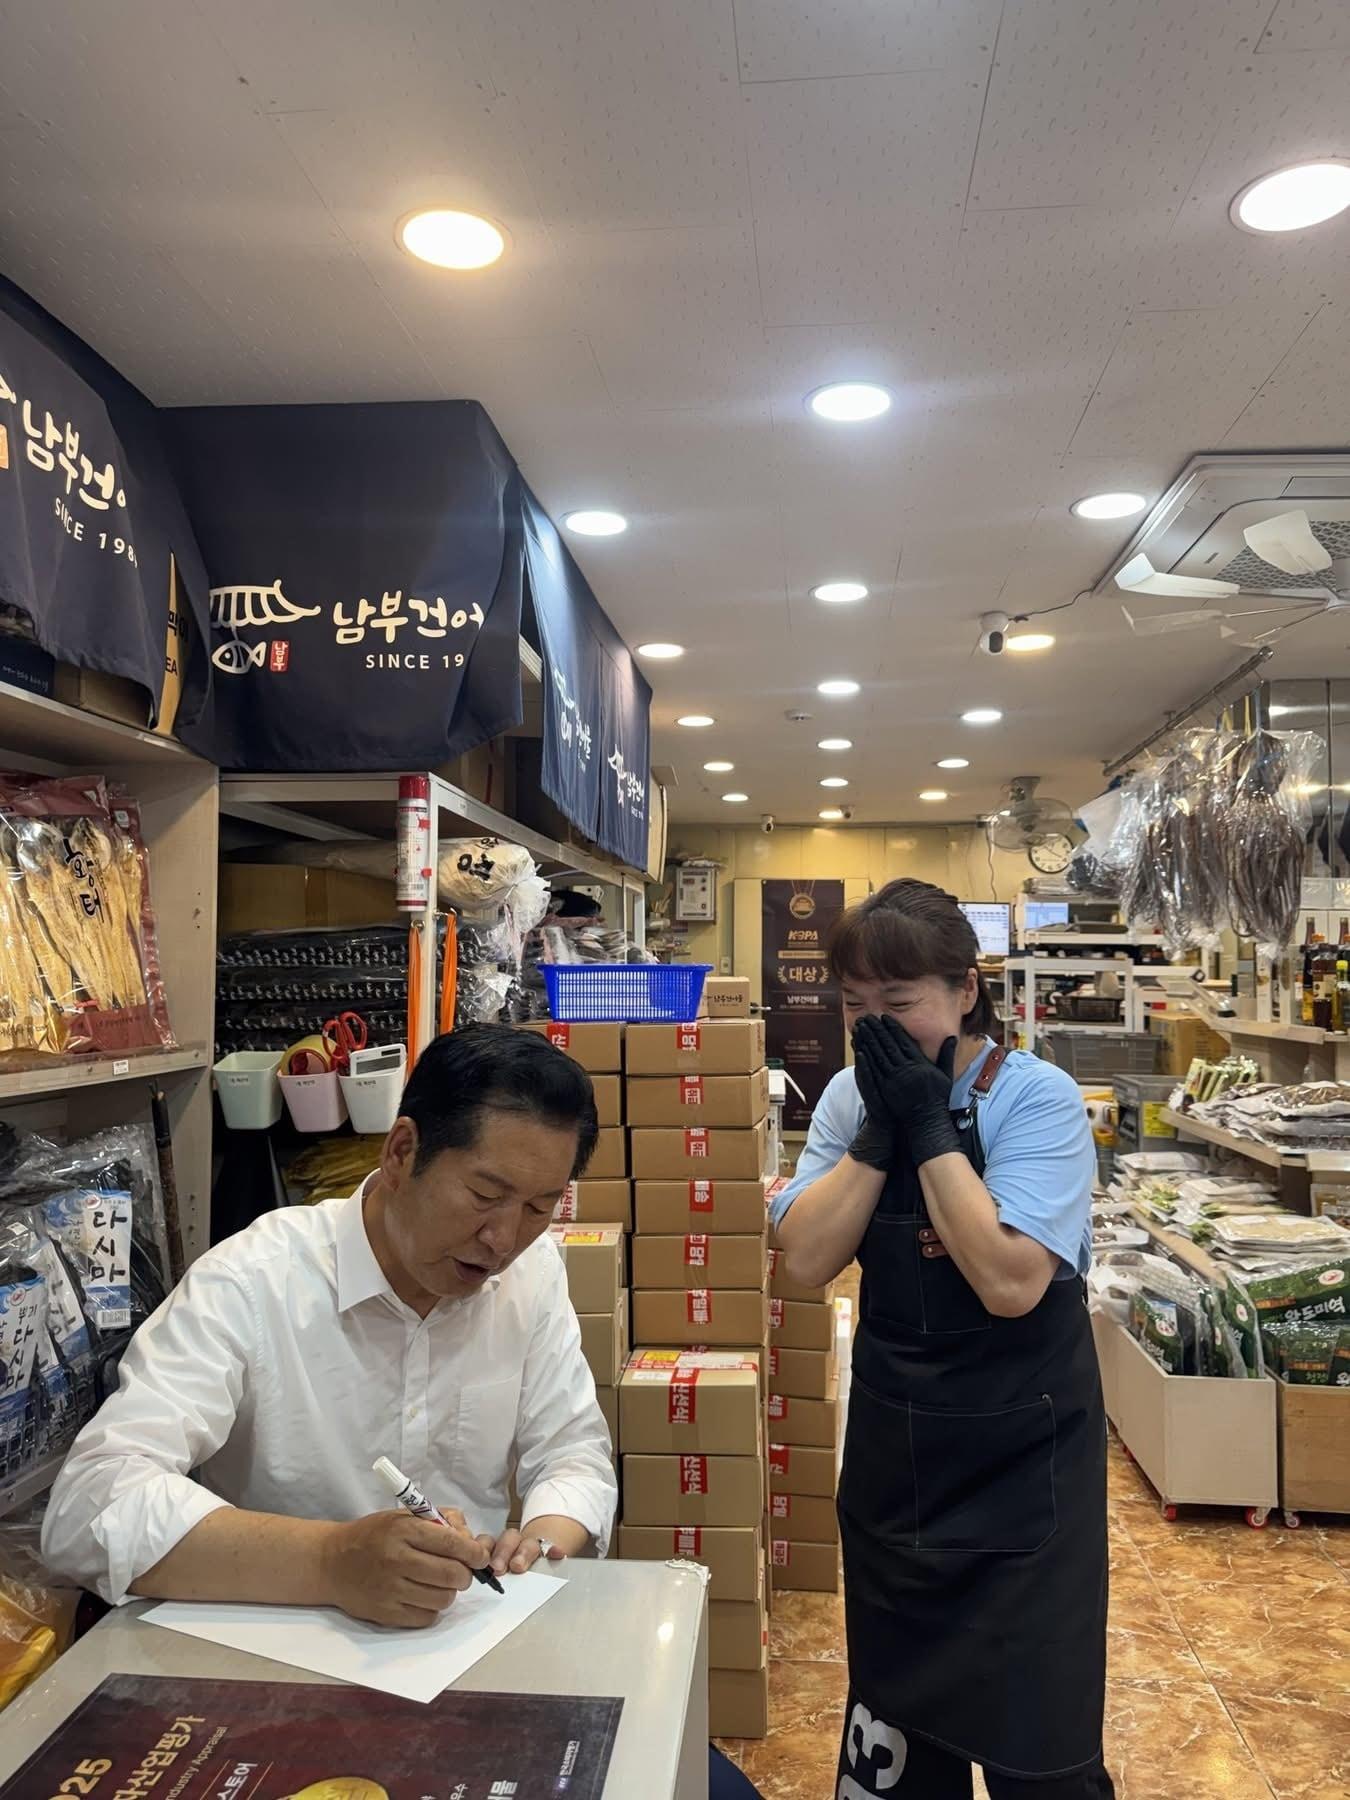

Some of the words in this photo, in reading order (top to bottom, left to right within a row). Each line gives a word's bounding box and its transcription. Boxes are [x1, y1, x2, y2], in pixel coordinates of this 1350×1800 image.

[55, 497, 85, 541] SINCE
[99, 533, 138, 568] 198
[366, 654, 430, 670] SINCE
[789, 966, 817, 982] 대상
[93, 1210, 128, 1283] 다시마
[6, 1324, 34, 1390] 다시마
[195, 1726, 228, 1768] Appraisal
